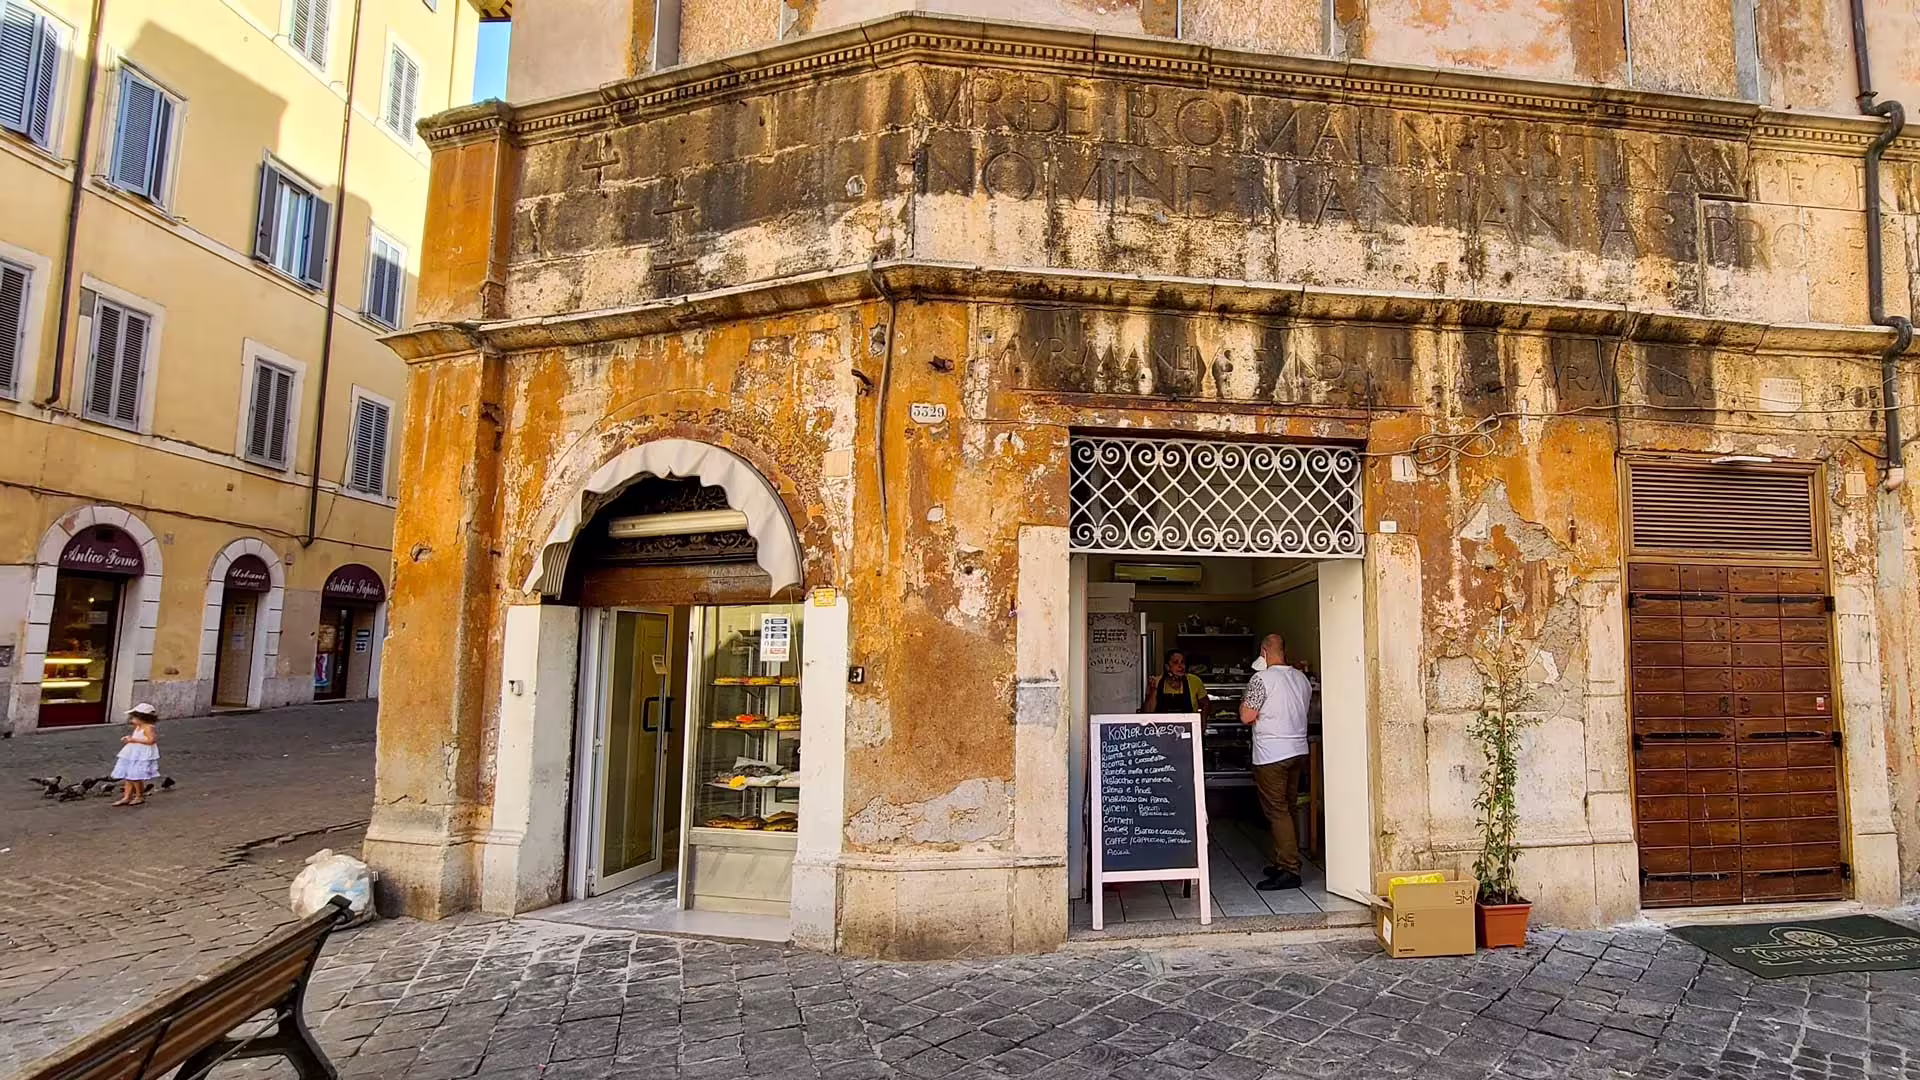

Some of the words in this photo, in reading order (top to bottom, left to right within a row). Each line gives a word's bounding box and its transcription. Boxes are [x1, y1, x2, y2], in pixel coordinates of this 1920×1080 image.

[64, 544, 105, 563] Antico
[106, 548, 139, 567] Forno
[326, 576, 355, 592] Antichi
